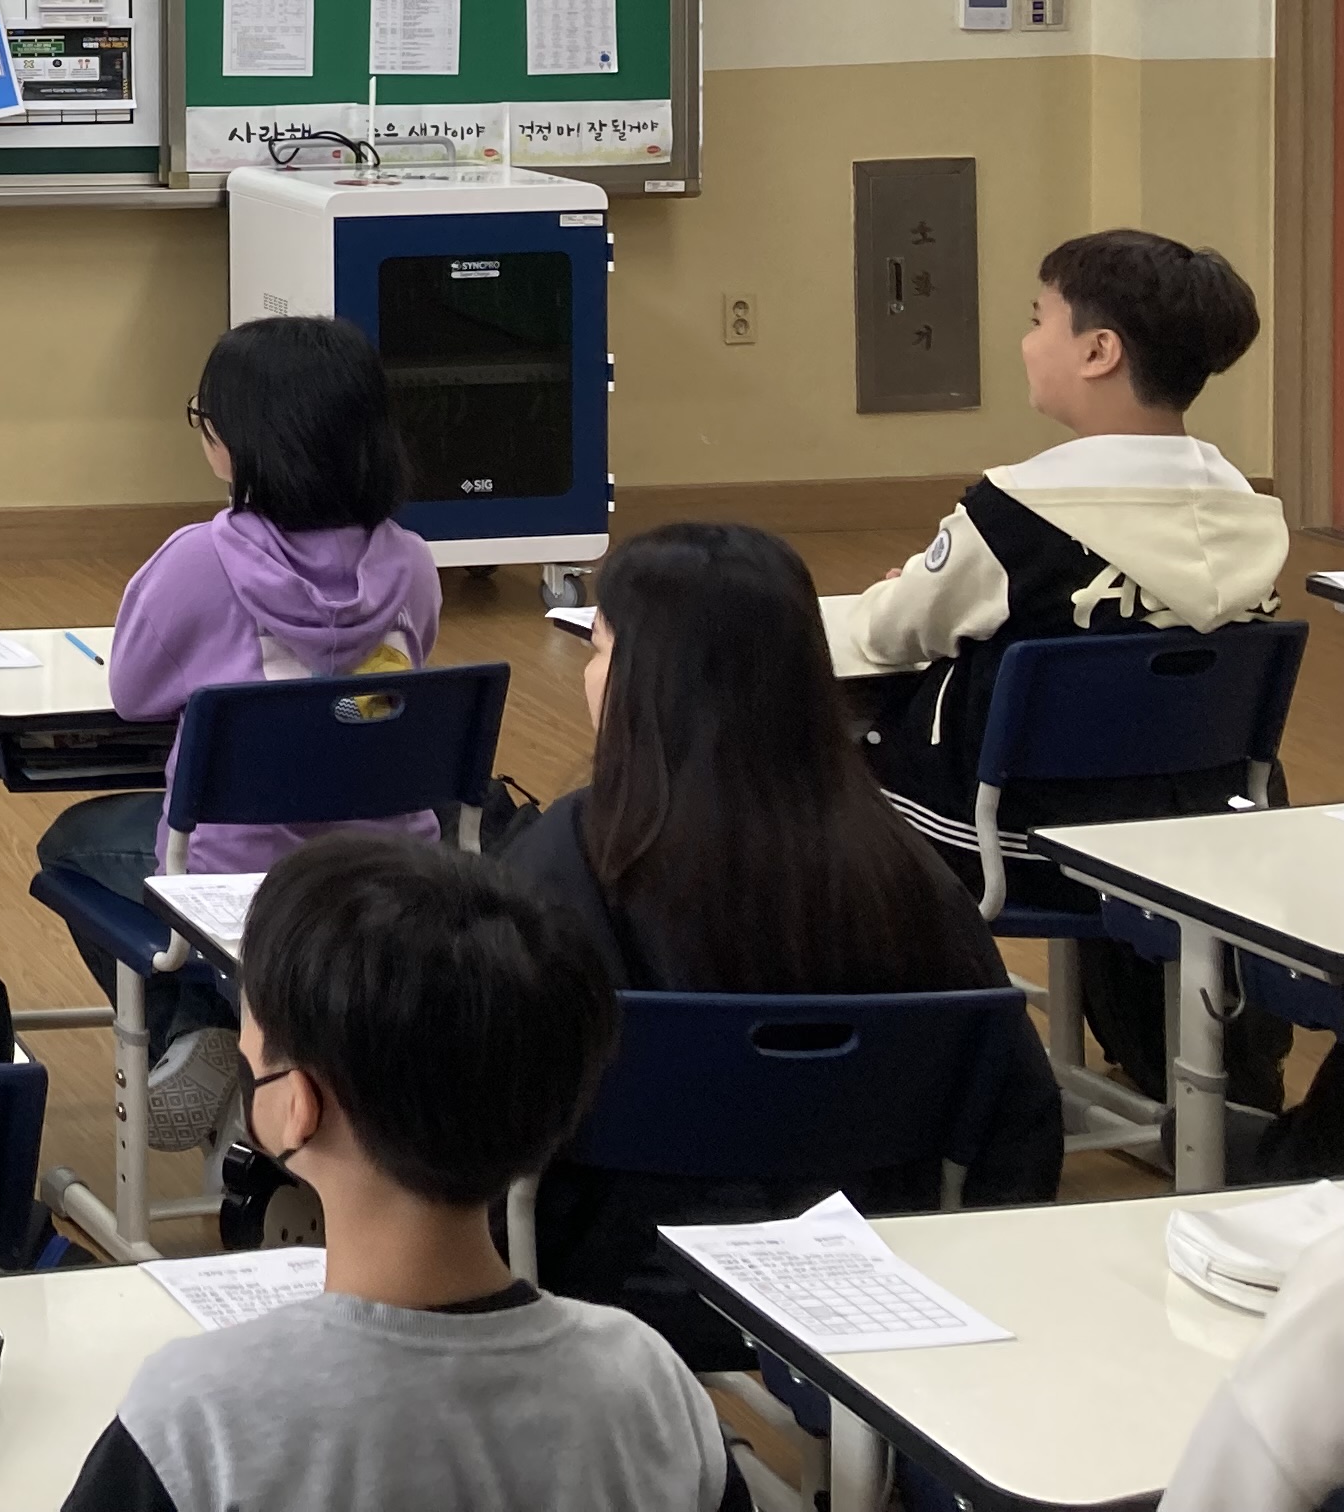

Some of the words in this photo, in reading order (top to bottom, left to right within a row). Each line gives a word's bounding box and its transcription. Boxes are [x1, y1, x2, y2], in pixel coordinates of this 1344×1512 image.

[518, 120, 551, 142] 걱정
[556, 123, 580, 138] 마!
[587, 119, 607, 142] 잘
[462, 261, 500, 270] SYNCPRO
[474, 479, 492, 489] SIG
